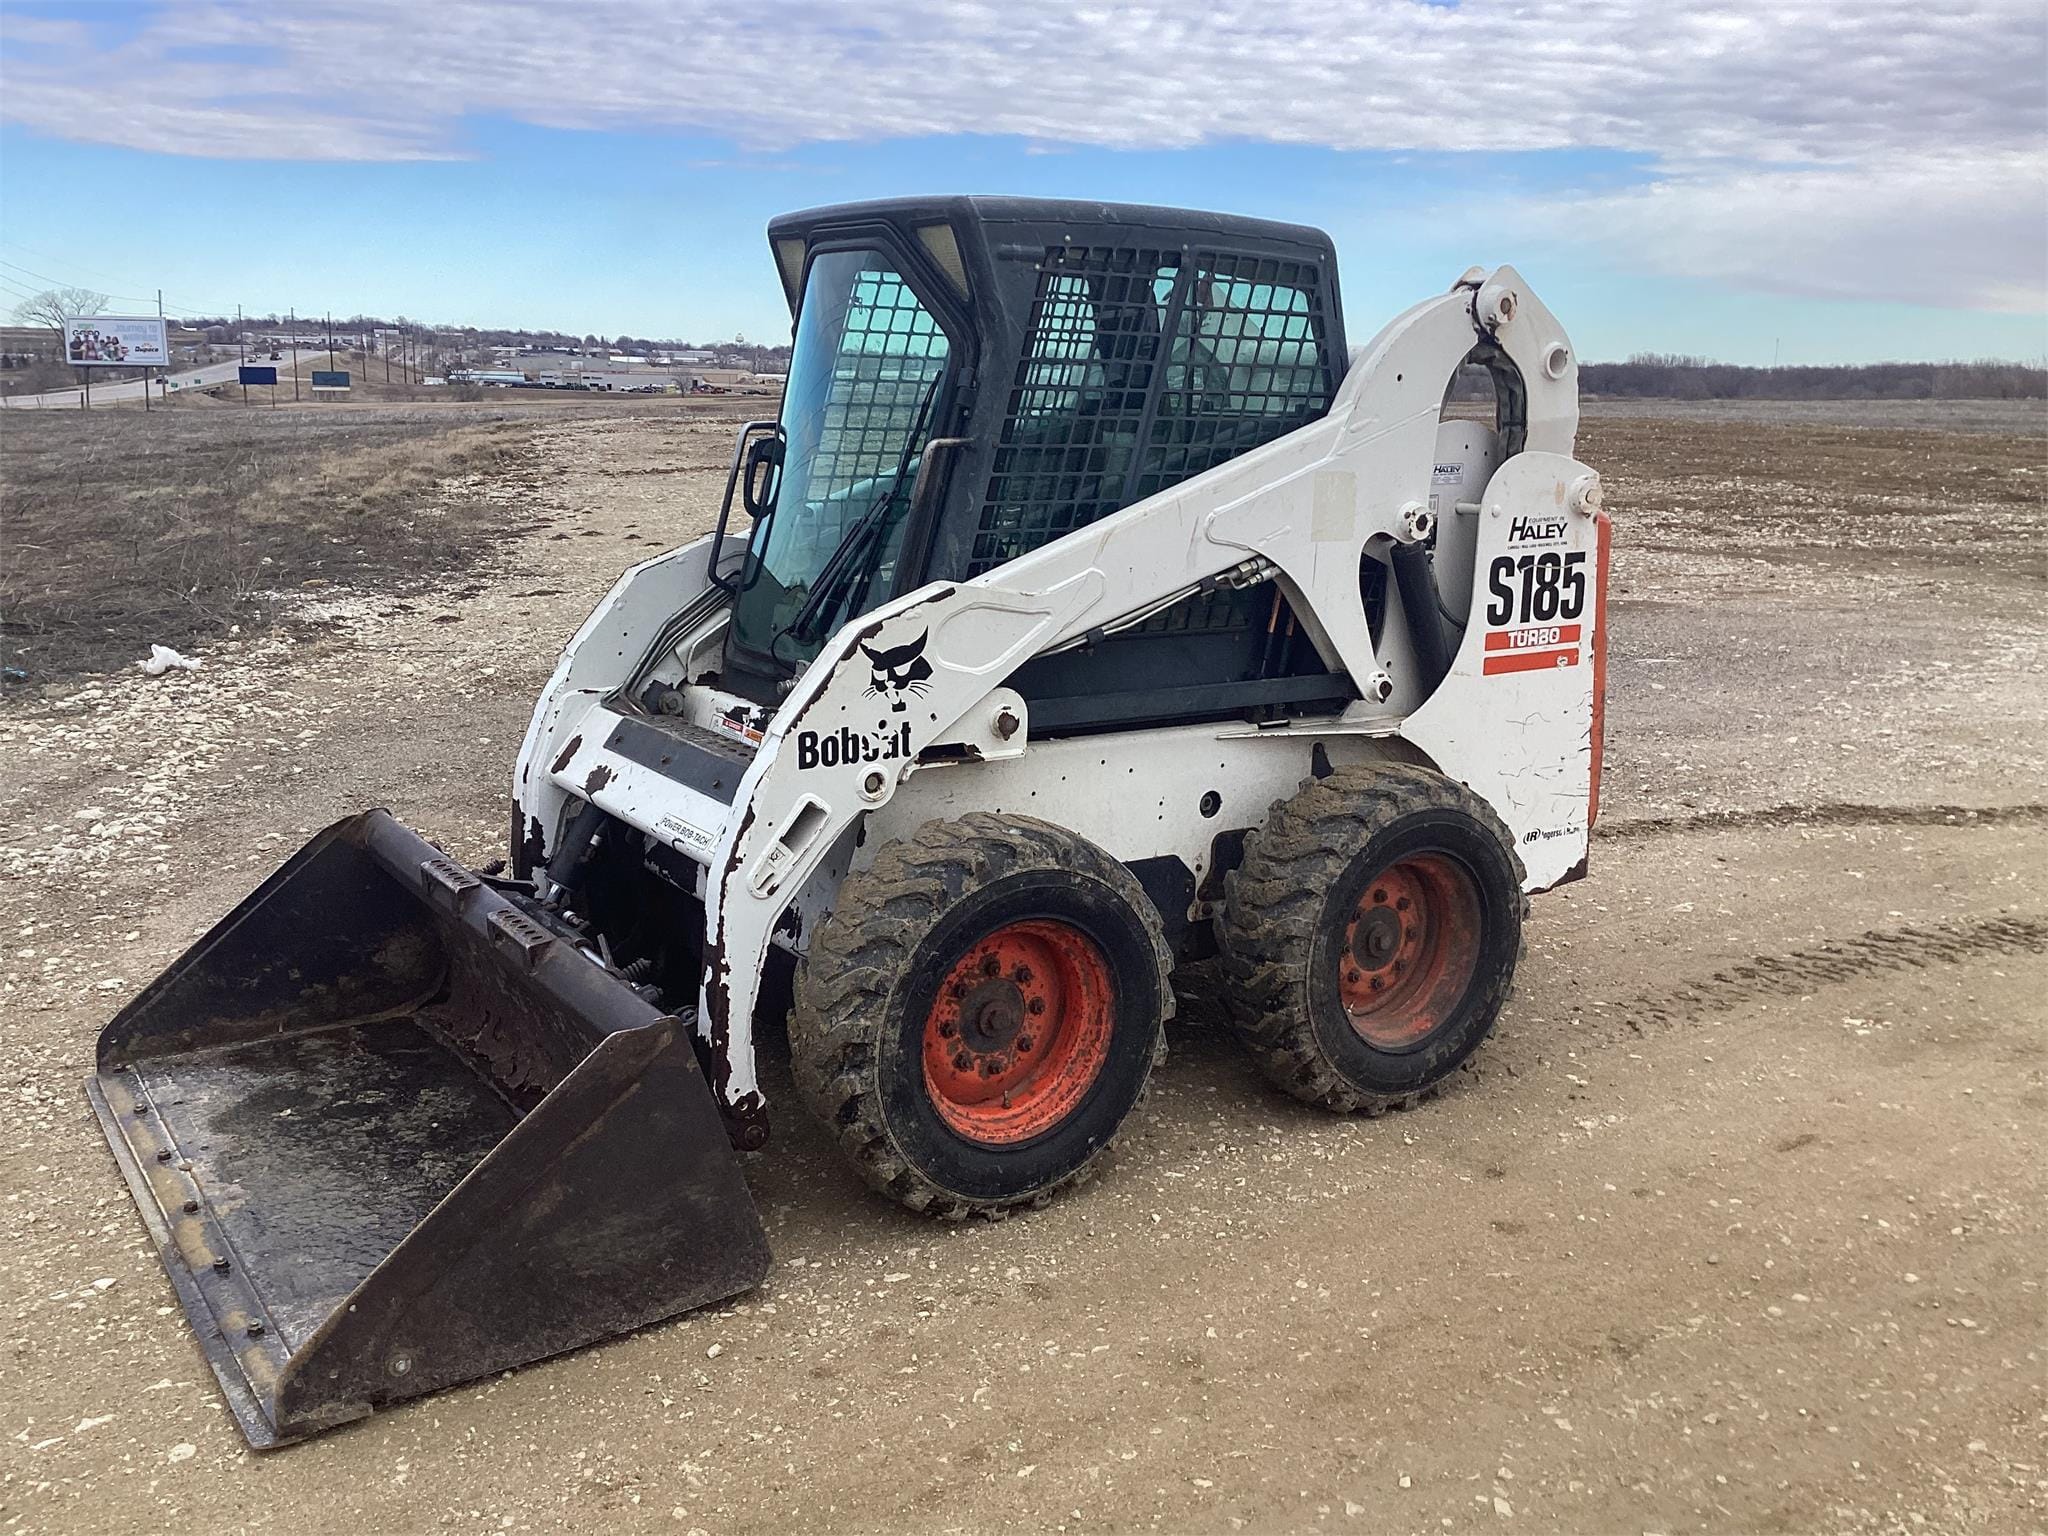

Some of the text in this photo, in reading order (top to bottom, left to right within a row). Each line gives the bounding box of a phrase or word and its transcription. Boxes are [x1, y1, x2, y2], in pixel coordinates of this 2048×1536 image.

[1508, 516, 1568, 542] HALEY
[1487, 552, 1585, 626] S185
[1508, 627, 1560, 648] TURBO
[798, 721, 911, 770] Bobcat
